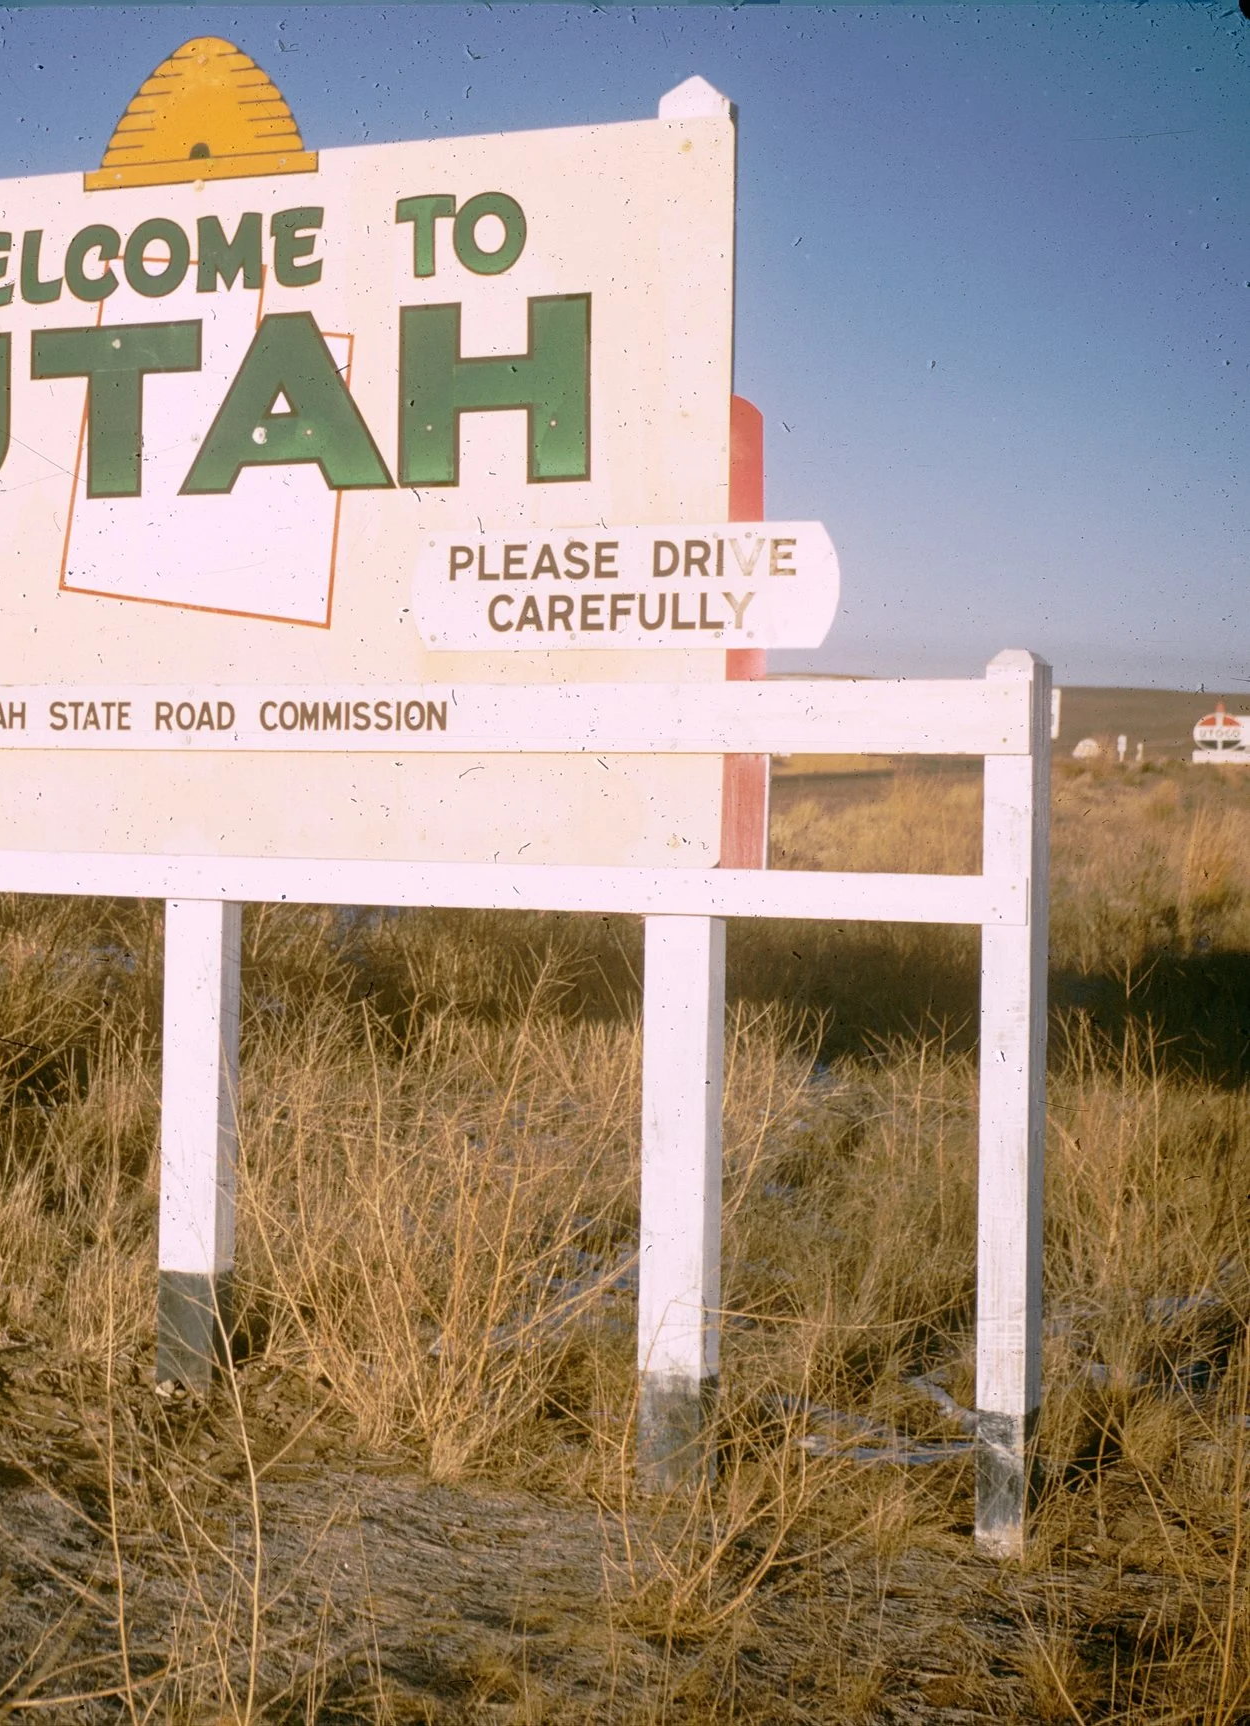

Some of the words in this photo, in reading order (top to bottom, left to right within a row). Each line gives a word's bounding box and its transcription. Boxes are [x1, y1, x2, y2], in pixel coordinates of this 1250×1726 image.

[396, 191, 526, 278] TO
[449, 540, 619, 581] PLEASE
[652, 537, 797, 578] DRIVE
[488, 591, 755, 632] CAREFULLY
[49, 701, 131, 731] STATE
[155, 701, 235, 731] ROAD
[259, 700, 448, 731] COMMISSION
